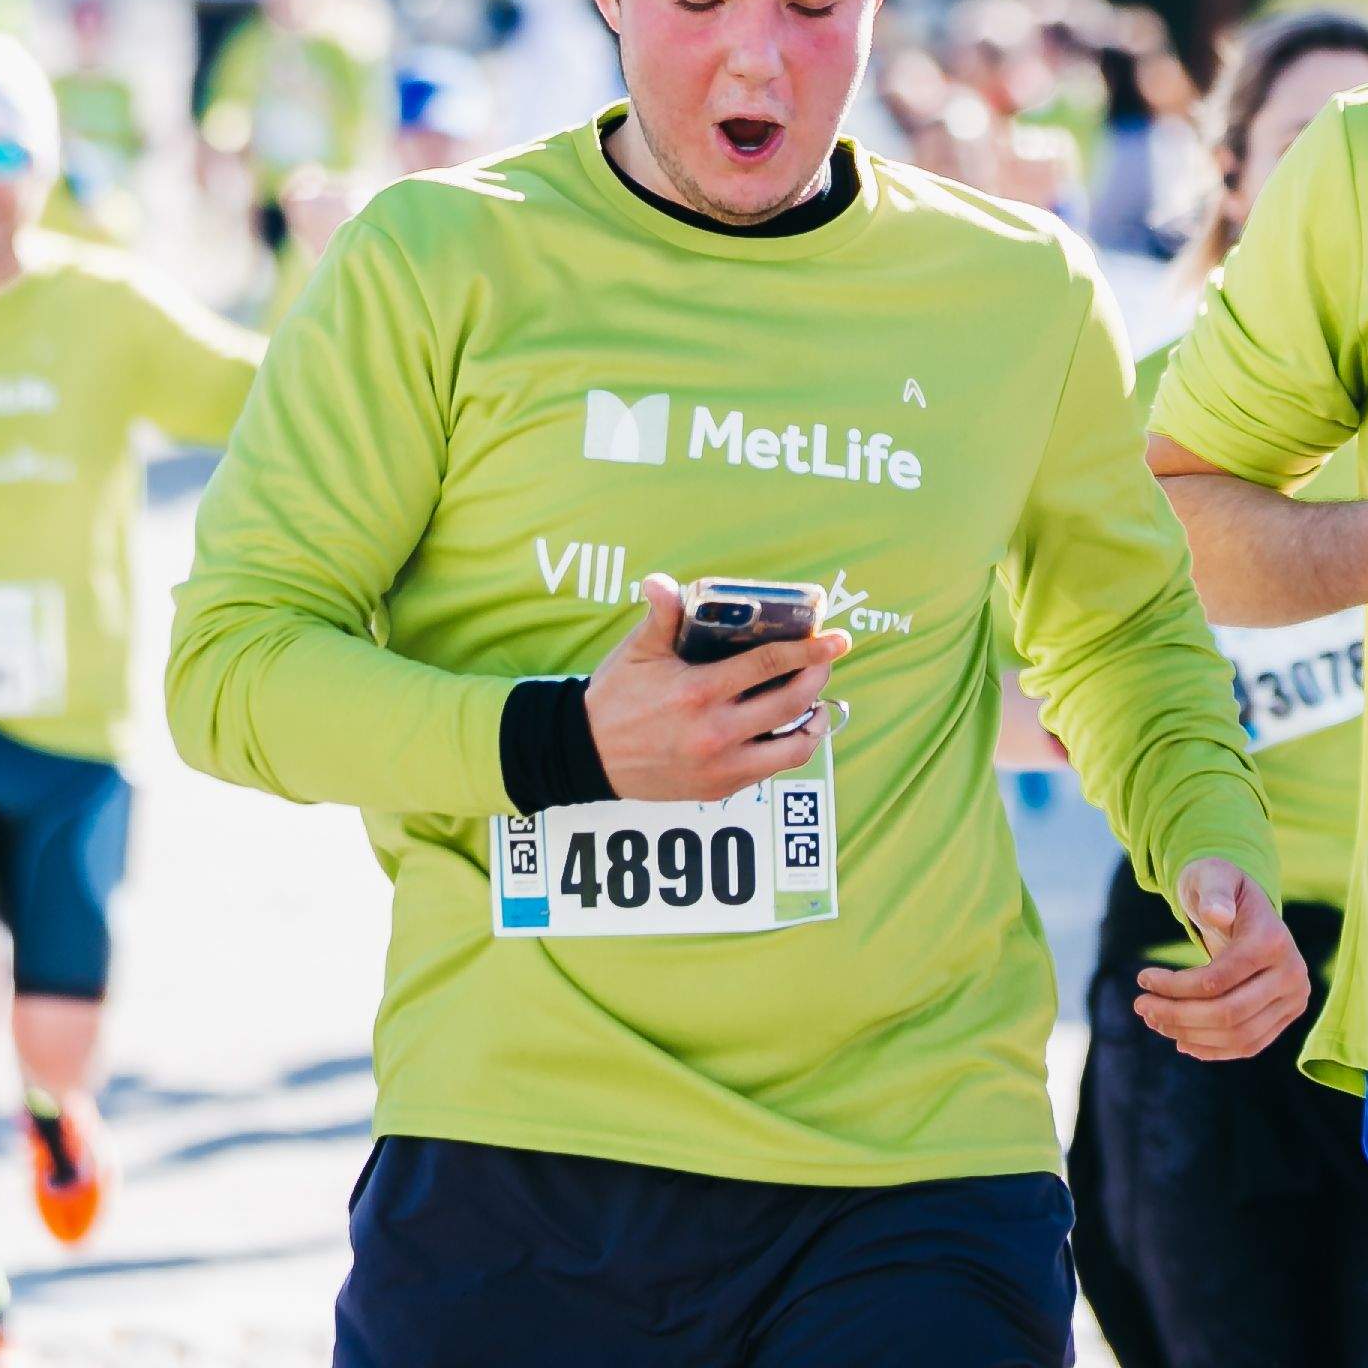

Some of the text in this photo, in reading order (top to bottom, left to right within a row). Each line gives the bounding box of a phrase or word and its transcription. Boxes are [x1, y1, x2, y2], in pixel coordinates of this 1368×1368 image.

[688, 405, 923, 491] MetLife
[535, 538, 626, 604] VIII
[560, 826, 756, 909] 4890
